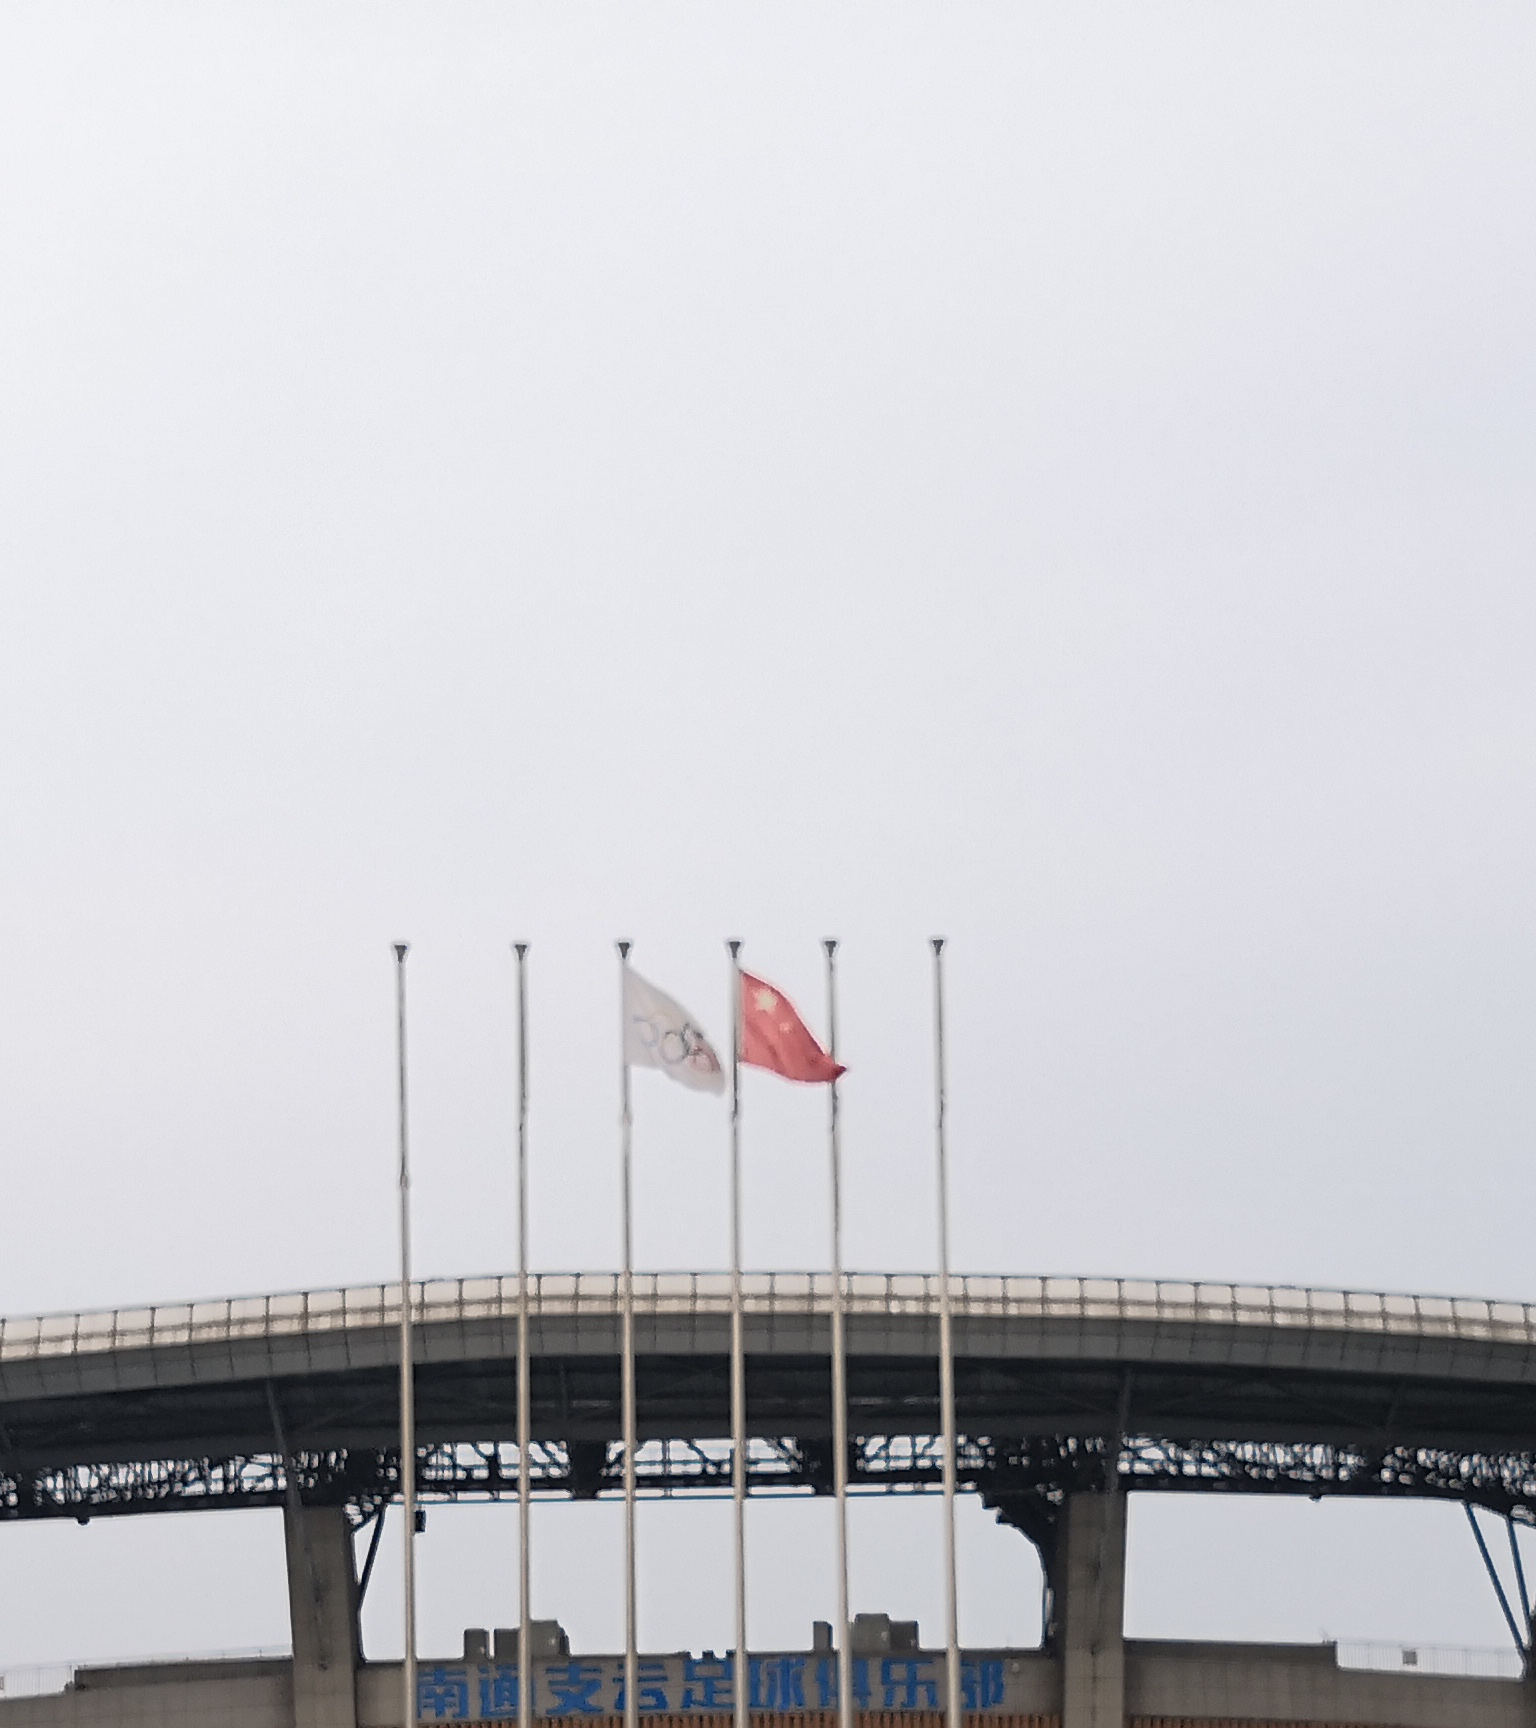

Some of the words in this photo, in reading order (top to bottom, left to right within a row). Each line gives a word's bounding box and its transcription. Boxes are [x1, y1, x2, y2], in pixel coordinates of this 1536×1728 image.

[417, 1650, 1004, 1719] 南通支云足球俱乐部
